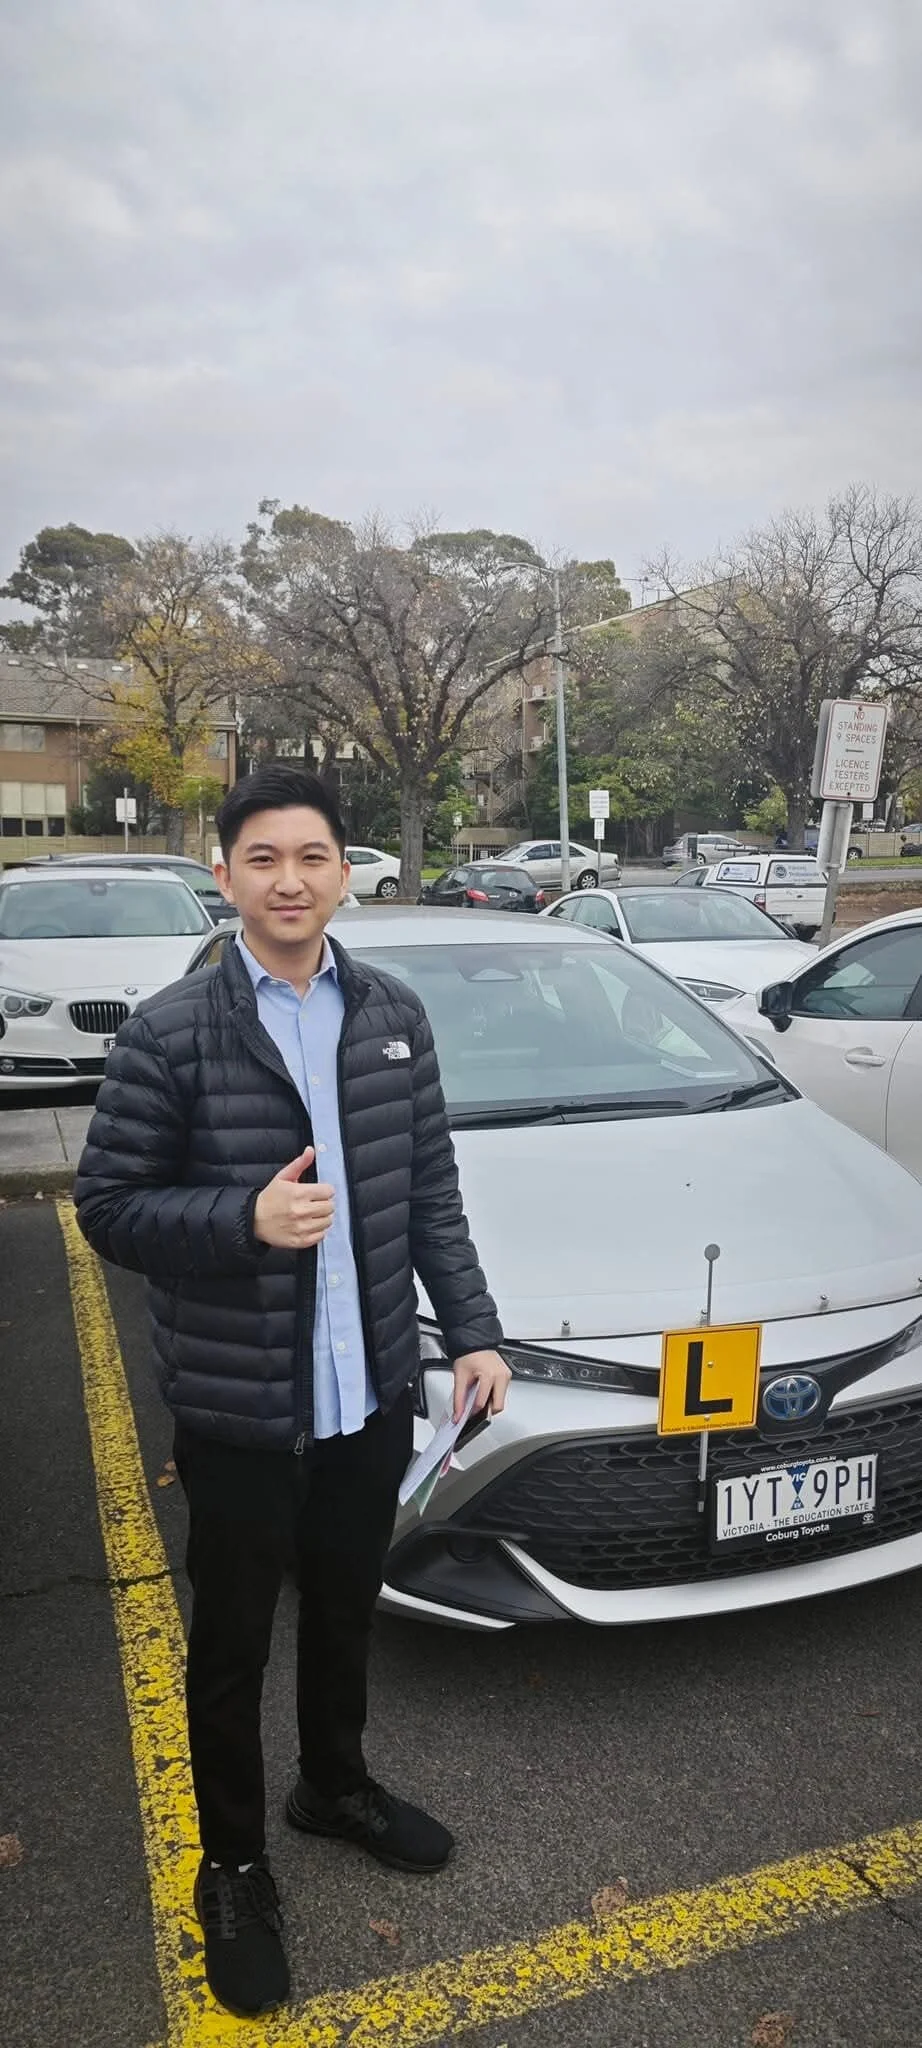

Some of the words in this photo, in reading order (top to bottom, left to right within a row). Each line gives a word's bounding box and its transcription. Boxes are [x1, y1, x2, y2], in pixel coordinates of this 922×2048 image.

[854, 711, 865, 720] NO
[838, 721, 878, 733] STANDING
[845, 733, 877, 744] SPACES
[835, 759, 871, 770] LICENCE
[834, 770, 870, 781] TESTERS
[829, 781, 871, 793] EXCEPTED
[684, 1341, 733, 1416] L
[760, 1456, 837, 1472] www.coburgtoyota.com.au
[722, 1523, 765, 1537] VICTORIA
[774, 1517, 791, 1528] THE
[793, 1508, 842, 1524] EDUCATION
[844, 1502, 870, 1514] STATE
[765, 1527, 800, 1542] Coburg
[801, 1523, 830, 1537] Toyota
